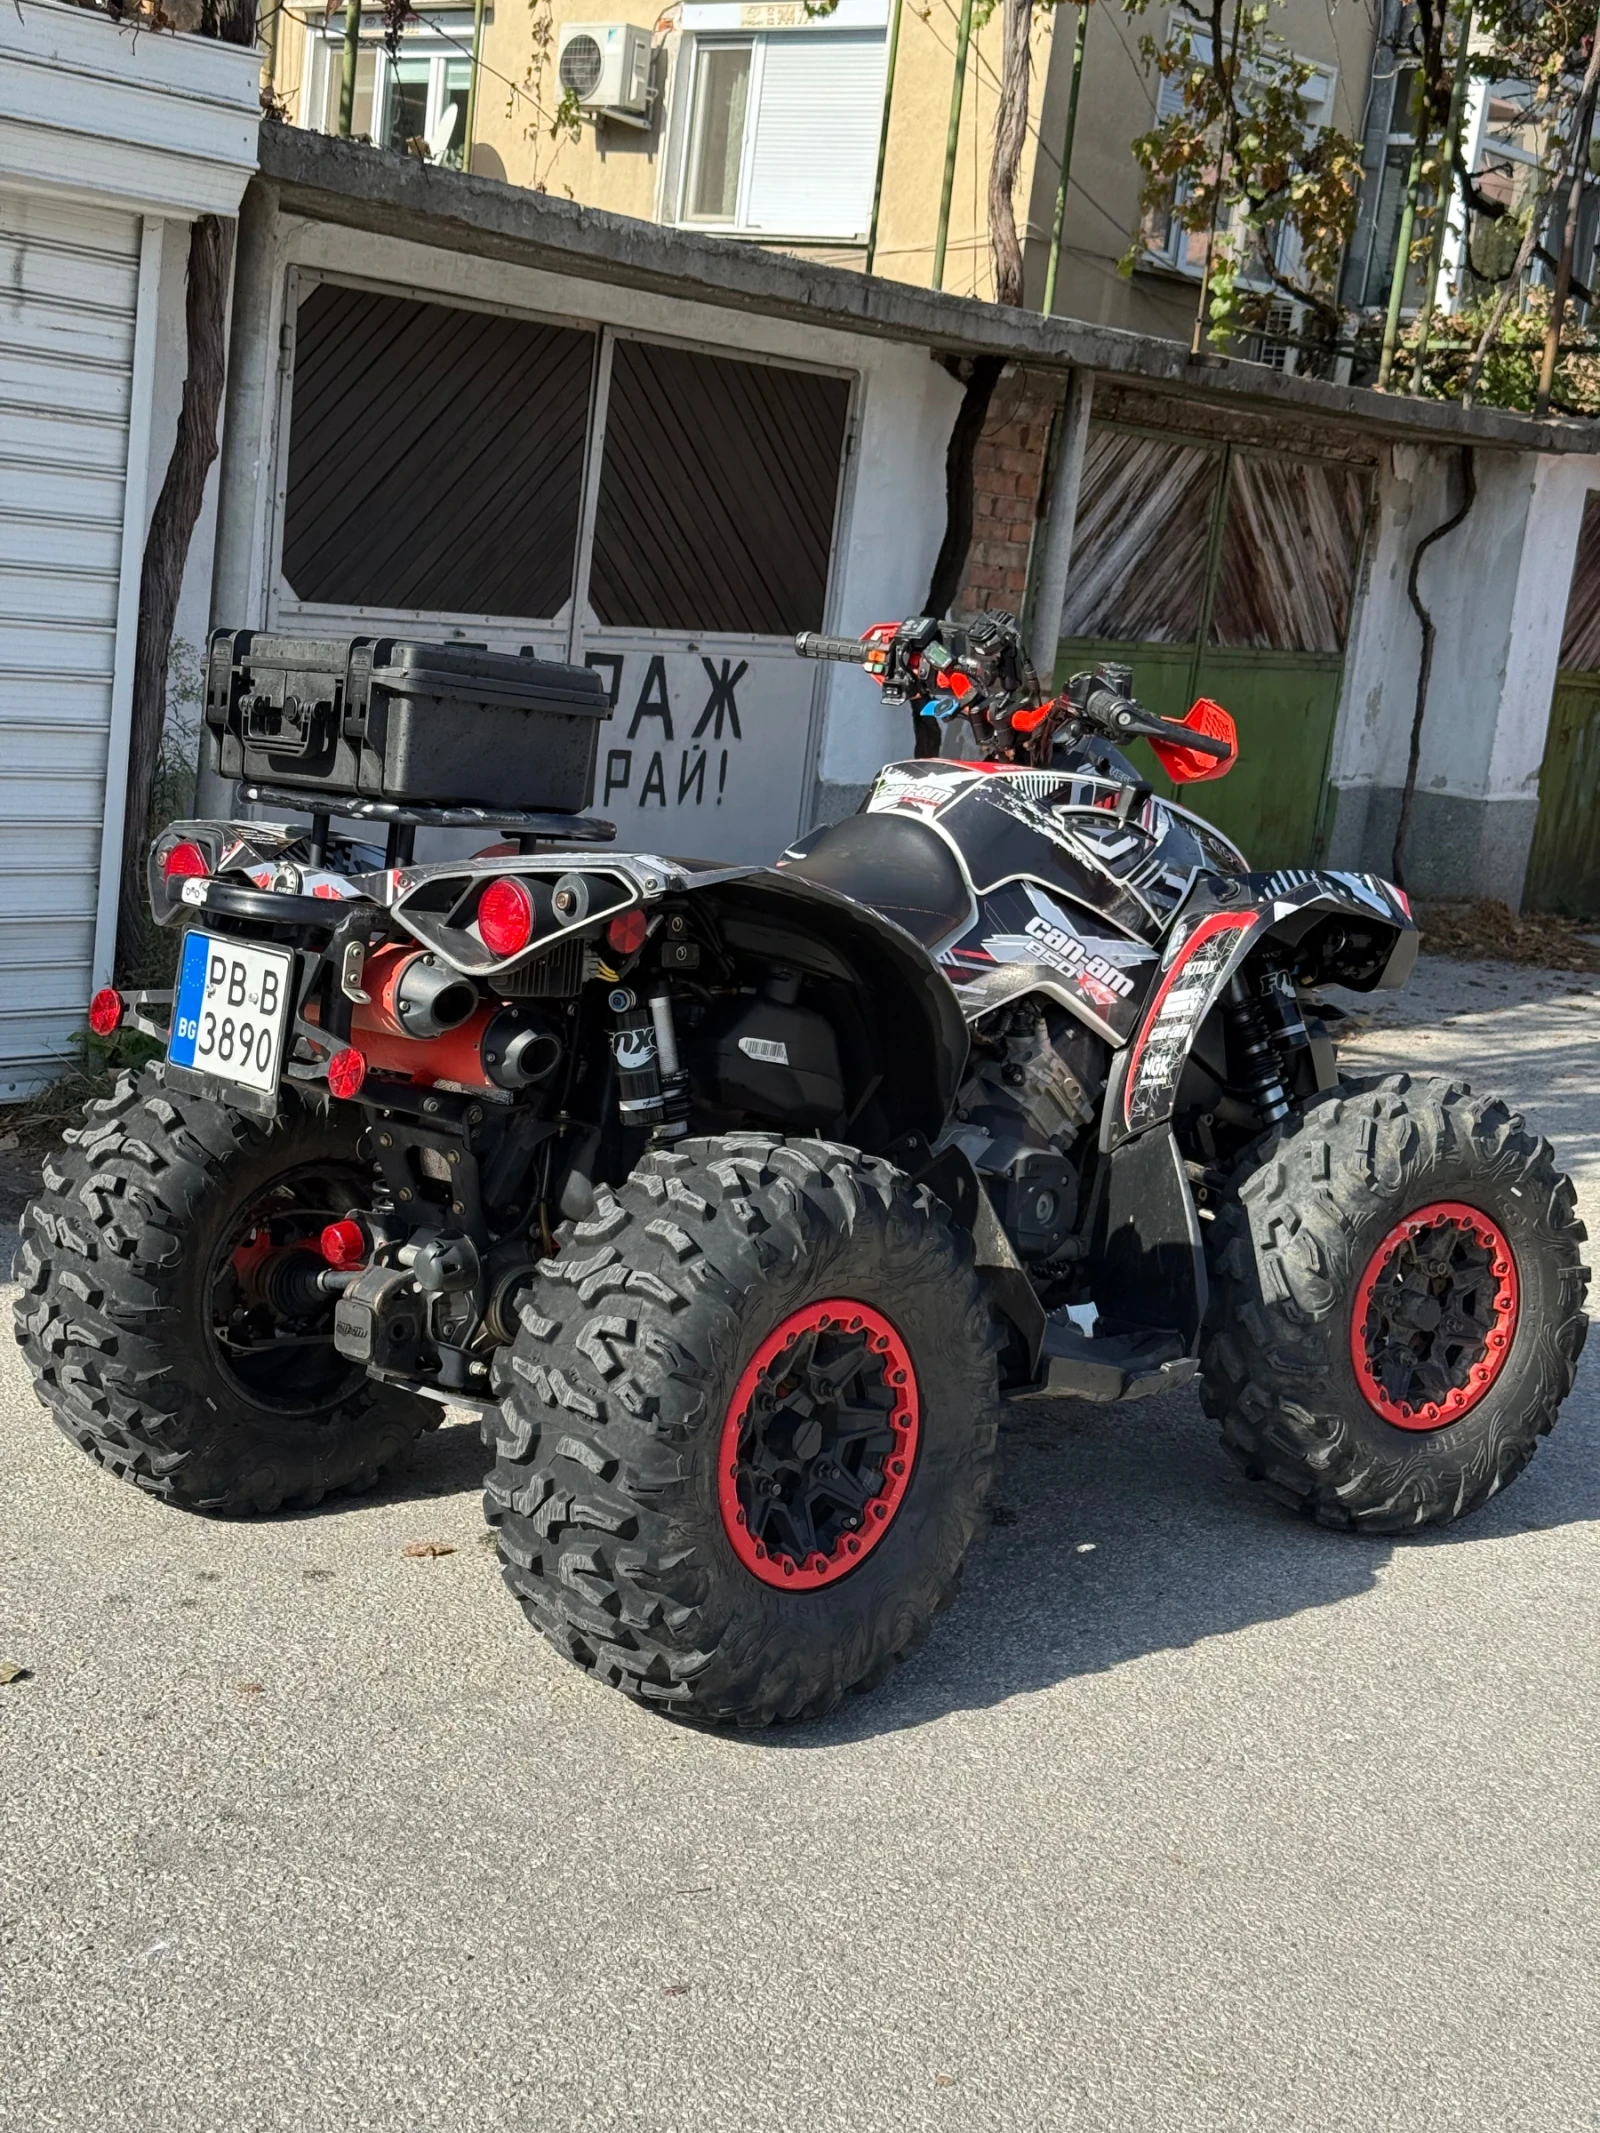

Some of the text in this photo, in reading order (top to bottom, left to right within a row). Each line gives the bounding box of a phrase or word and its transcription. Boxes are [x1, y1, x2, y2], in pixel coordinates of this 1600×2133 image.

[591, 744, 728, 807] РАЙ!
[1024, 916, 1135, 998] can-am
[1024, 940, 1078, 978] 850
[1182, 959, 1217, 976] ROTAX
[1260, 969, 1293, 997] FO
[177, 1017, 197, 1040] BG
[199, 1011, 272, 1073] 3890
[608, 1026, 656, 1056] OX
[1141, 1054, 1172, 1078] NGK
